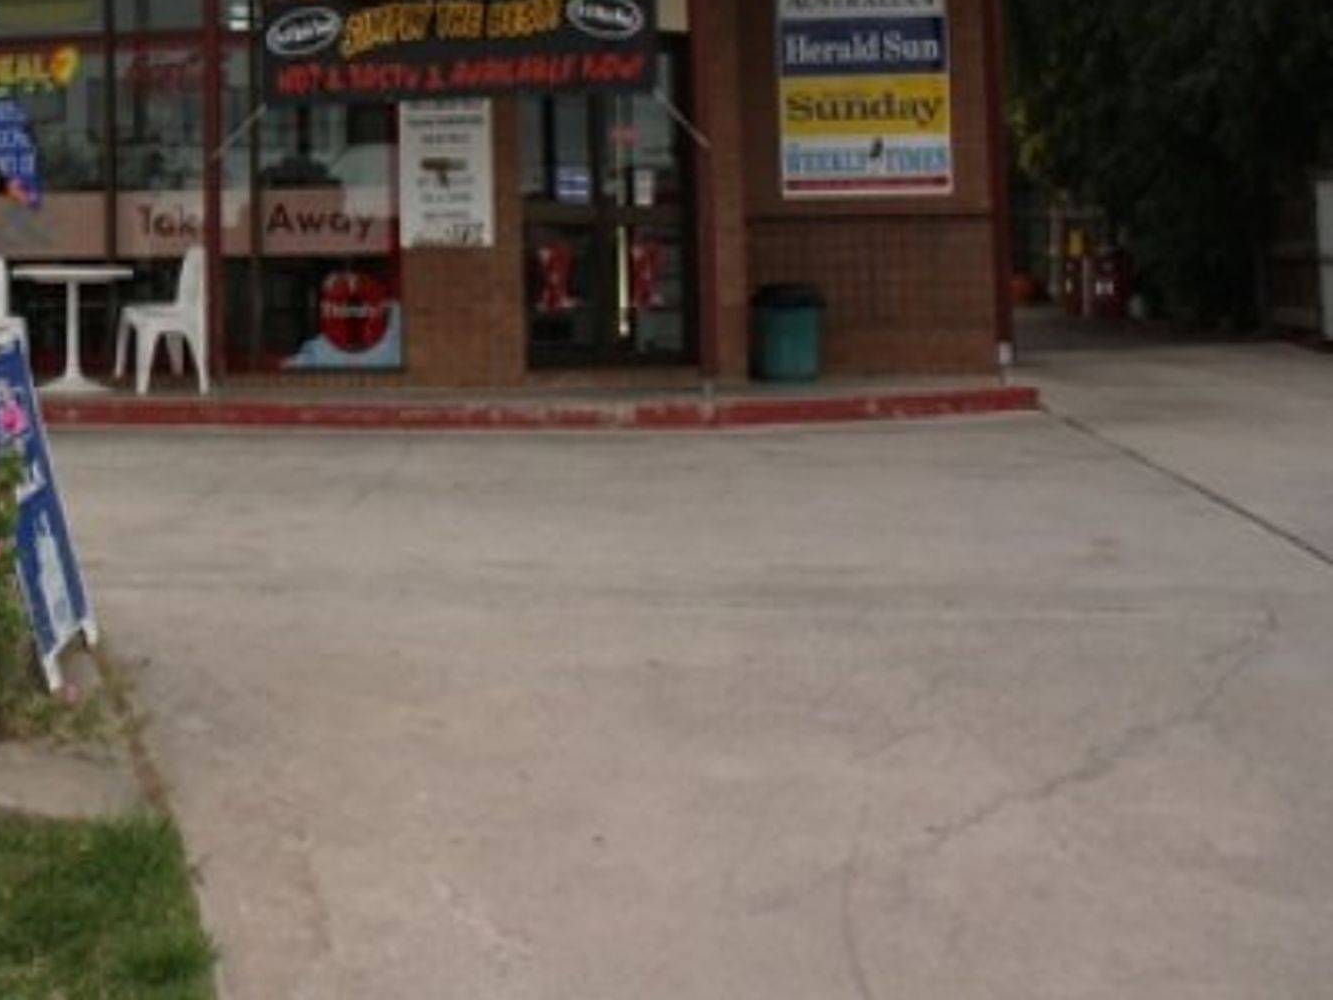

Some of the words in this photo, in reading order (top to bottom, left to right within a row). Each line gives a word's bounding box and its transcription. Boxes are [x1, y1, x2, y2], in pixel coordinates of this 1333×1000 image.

[783, 30, 880, 65] Herald
[882, 30, 940, 63] Sun
[786, 90, 944, 128] Sunday
[136, 202, 201, 238] Tak
[266, 202, 375, 244] Away
